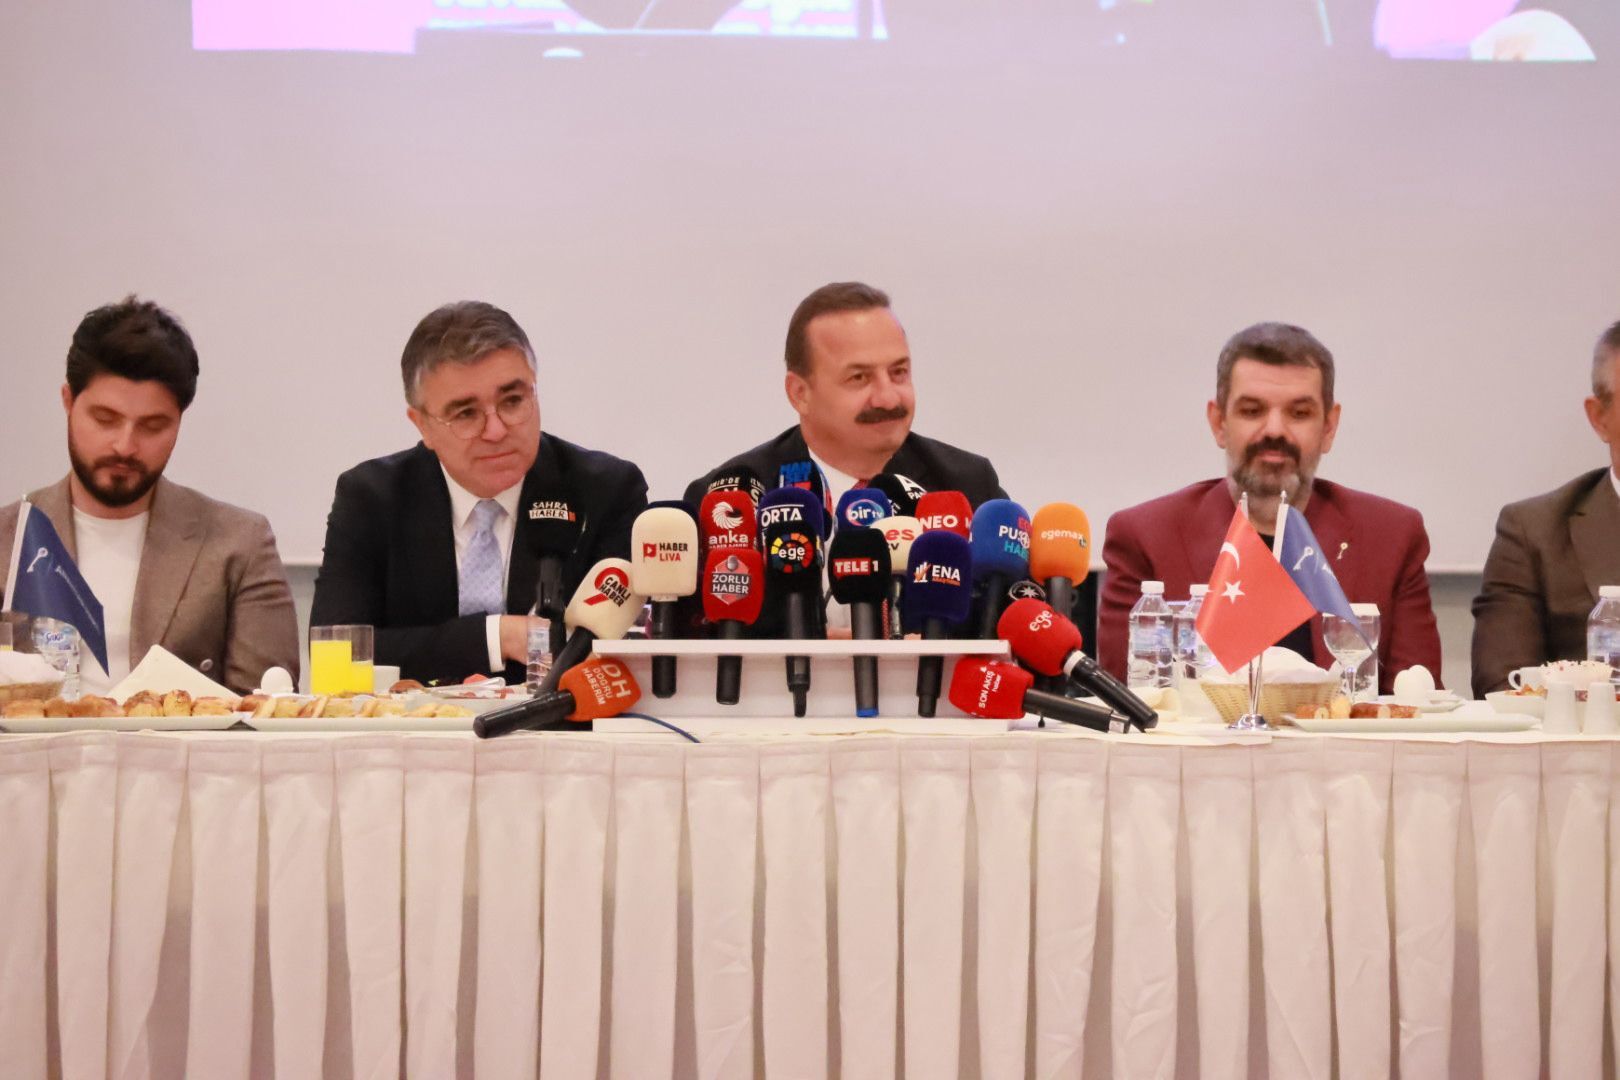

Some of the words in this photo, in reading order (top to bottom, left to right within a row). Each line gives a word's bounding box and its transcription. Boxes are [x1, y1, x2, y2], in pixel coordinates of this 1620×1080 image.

[532, 501, 568, 511] SAHRA
[531, 509, 565, 519] HABER
[761, 507, 803, 528] ORTA
[920, 514, 958, 529] NEO
[709, 530, 749, 545] anka
[659, 542, 688, 552] HABER
[778, 546, 805, 560] ege
[659, 552, 681, 562] LIVA
[834, 560, 869, 574] TELE
[872, 560, 879, 572] 1
[932, 564, 961, 582] ENA
[712, 573, 750, 585] ZORLU
[599, 583, 625, 607] HABER
[604, 576, 632, 602] CANLI
[712, 583, 750, 595] HABER
[1029, 610, 1053, 632] ege
[600, 663, 632, 698] DH
[978, 689, 989, 709] SON
